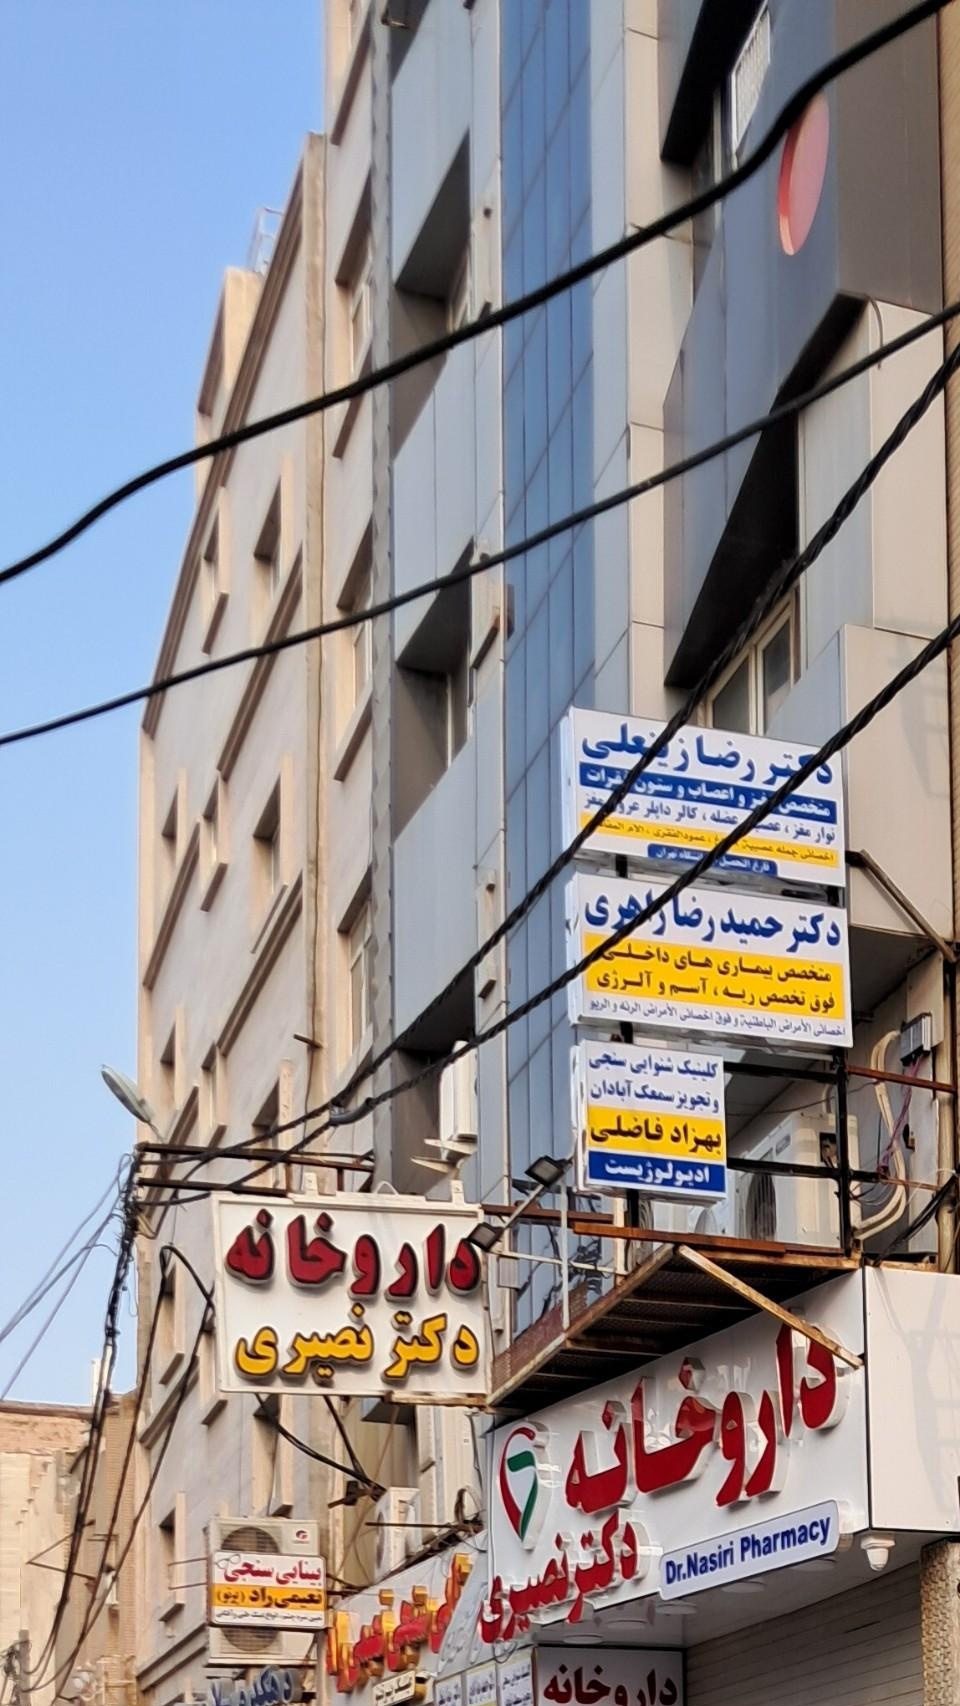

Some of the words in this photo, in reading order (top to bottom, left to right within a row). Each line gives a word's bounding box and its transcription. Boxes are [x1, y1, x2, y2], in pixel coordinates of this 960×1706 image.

[695, 733, 755, 782] رضا
[634, 776, 674, 796] ستون
[677, 786, 685, 799] و
[688, 782, 735, 801] اعصاب
[738, 793, 746, 808] و
[779, 799, 831, 817] متخصص
[786, 912, 841, 952] دکتر
[602, 943, 670, 963] داخلی
[675, 949, 713, 971] های
[596, 969, 652, 992] آلرژی
[717, 956, 774, 982] بیماری
[777, 967, 832, 983] متخصص
[658, 982, 665, 995] و
[669, 977, 707, 998] آسم
[758, 988, 807, 1008] تخصص
[809, 991, 836, 1014] فوق
[589, 1052, 627, 1070] سنجی
[630, 1054, 674, 1077] شنوایی
[677, 1059, 718, 1082] کلینیک
[590, 1078, 632, 1102] آبادان
[634, 1083, 675, 1103] سمعک
[676, 1091, 712, 1112] تجویز
[590, 1114, 664, 1143] فاضلی
[670, 1122, 722, 1155] بهزاد
[604, 1157, 710, 1187] ادیولوژیست
[226, 1208, 482, 1297] داروخانه
[235, 1301, 375, 1379] نصیری
[382, 1310, 480, 1379] دکتر
[565, 1321, 837, 1516] داروخانه
[664, 1540, 734, 1585] Dr.Nasiri
[740, 1515, 831, 1564] Pharmacy
[223, 1559, 274, 1583] سنجی
[276, 1560, 322, 1586] بینایی
[566, 1510, 638, 1624] دکتر
[478, 1531, 569, 1644] نصیری
